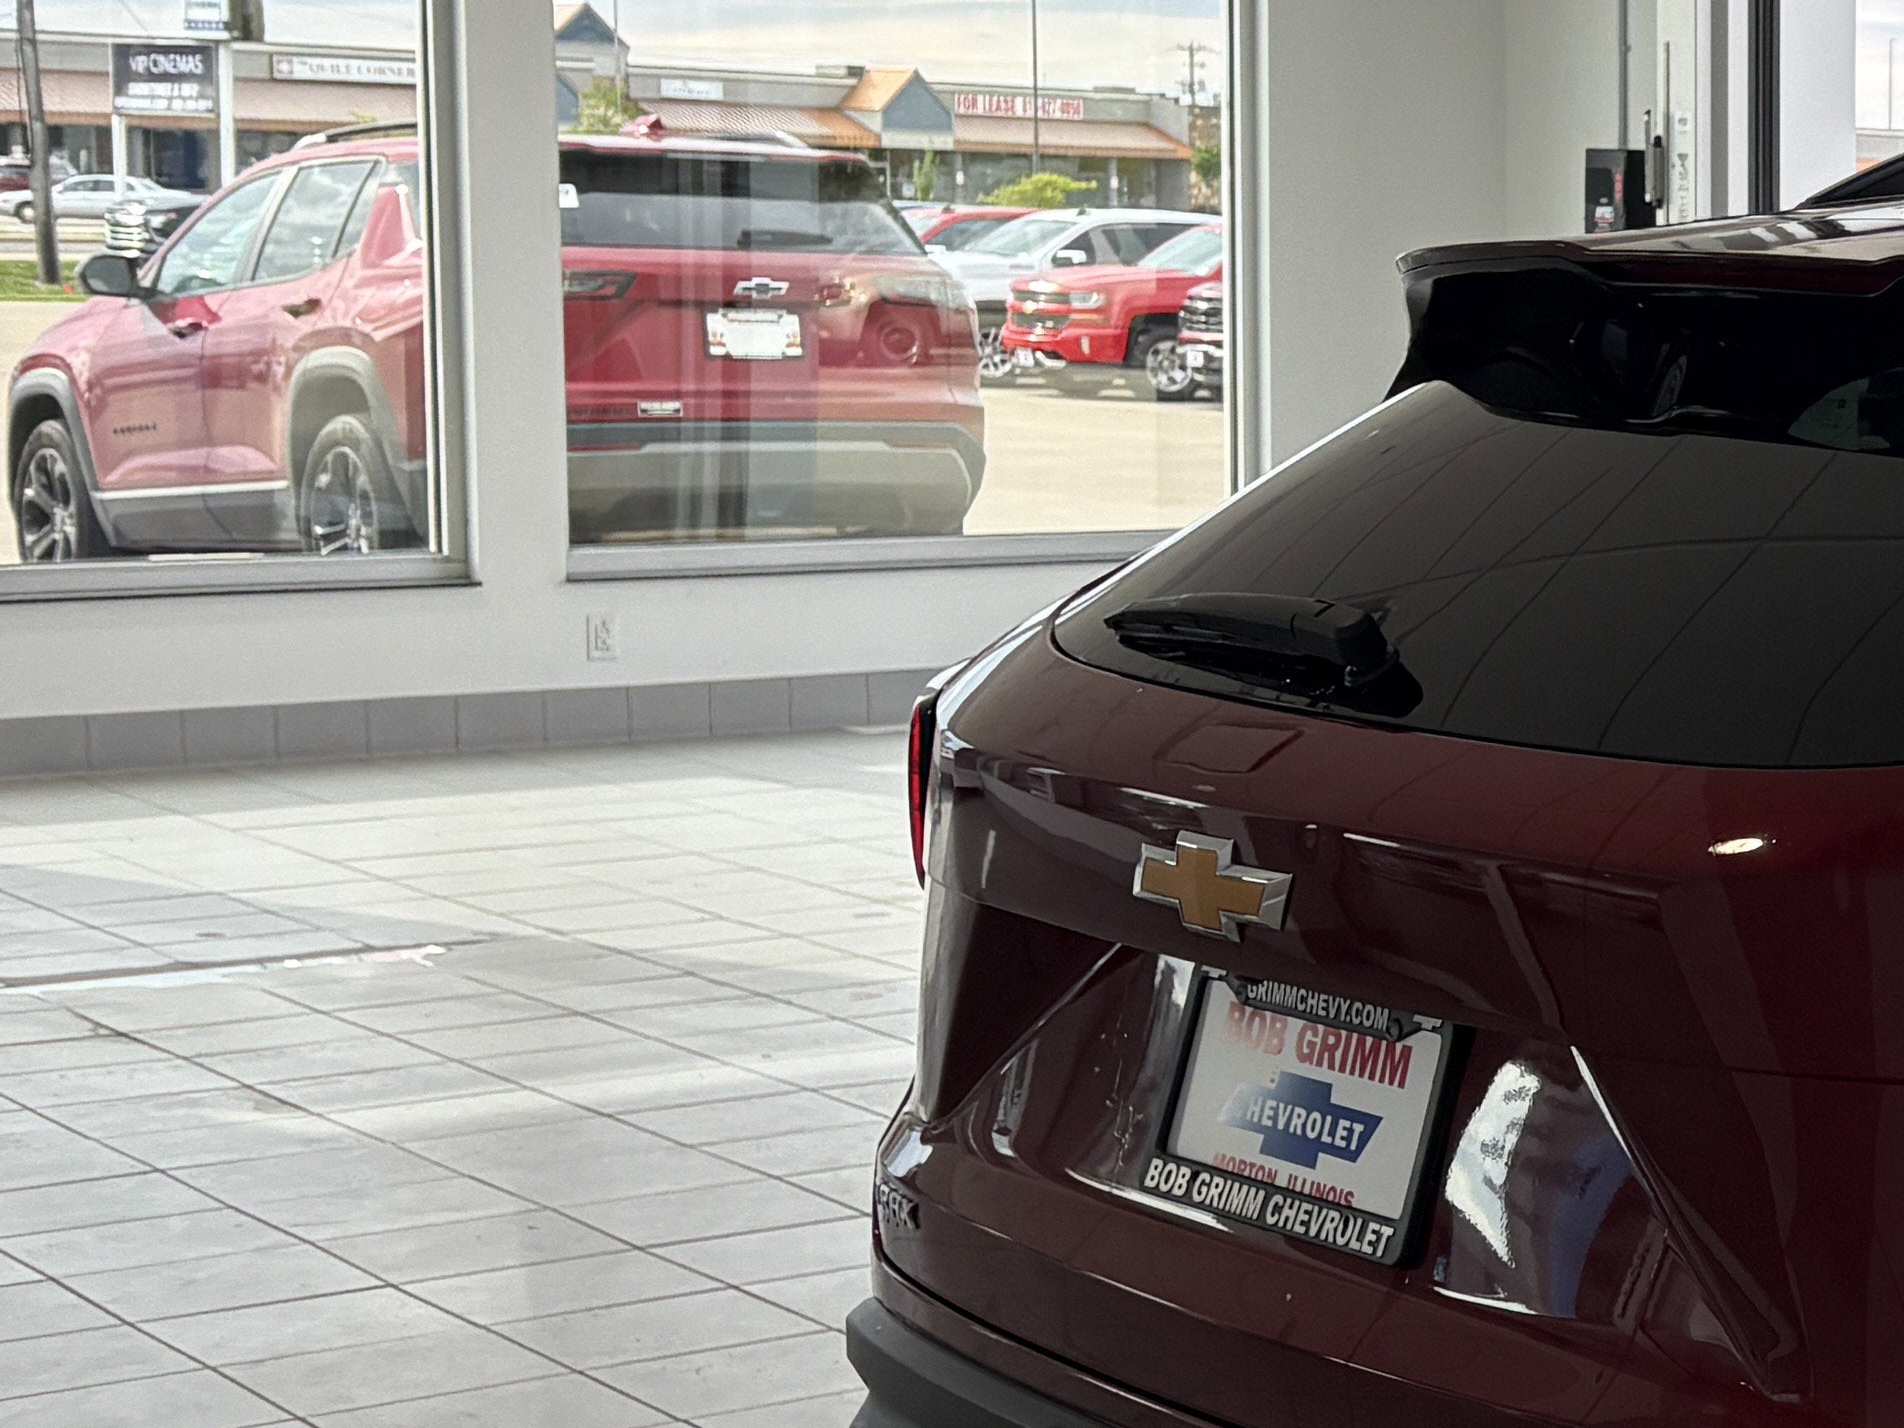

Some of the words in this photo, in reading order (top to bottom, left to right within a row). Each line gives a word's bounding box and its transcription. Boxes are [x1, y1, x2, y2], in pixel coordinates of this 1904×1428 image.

[128, 55, 148, 73] VIP
[149, 53, 203, 74] CINEMAS
[955, 94, 979, 114] FOR
[1225, 1000, 1290, 1055] BOB
[1295, 1022, 1413, 1090] GRIMM
[1238, 1094, 1365, 1151] HEVROLET
[1143, 1157, 1192, 1197] BOB
[1192, 1172, 1266, 1220] GRIMM
[1266, 1194, 1395, 1259] CHEVROLET
